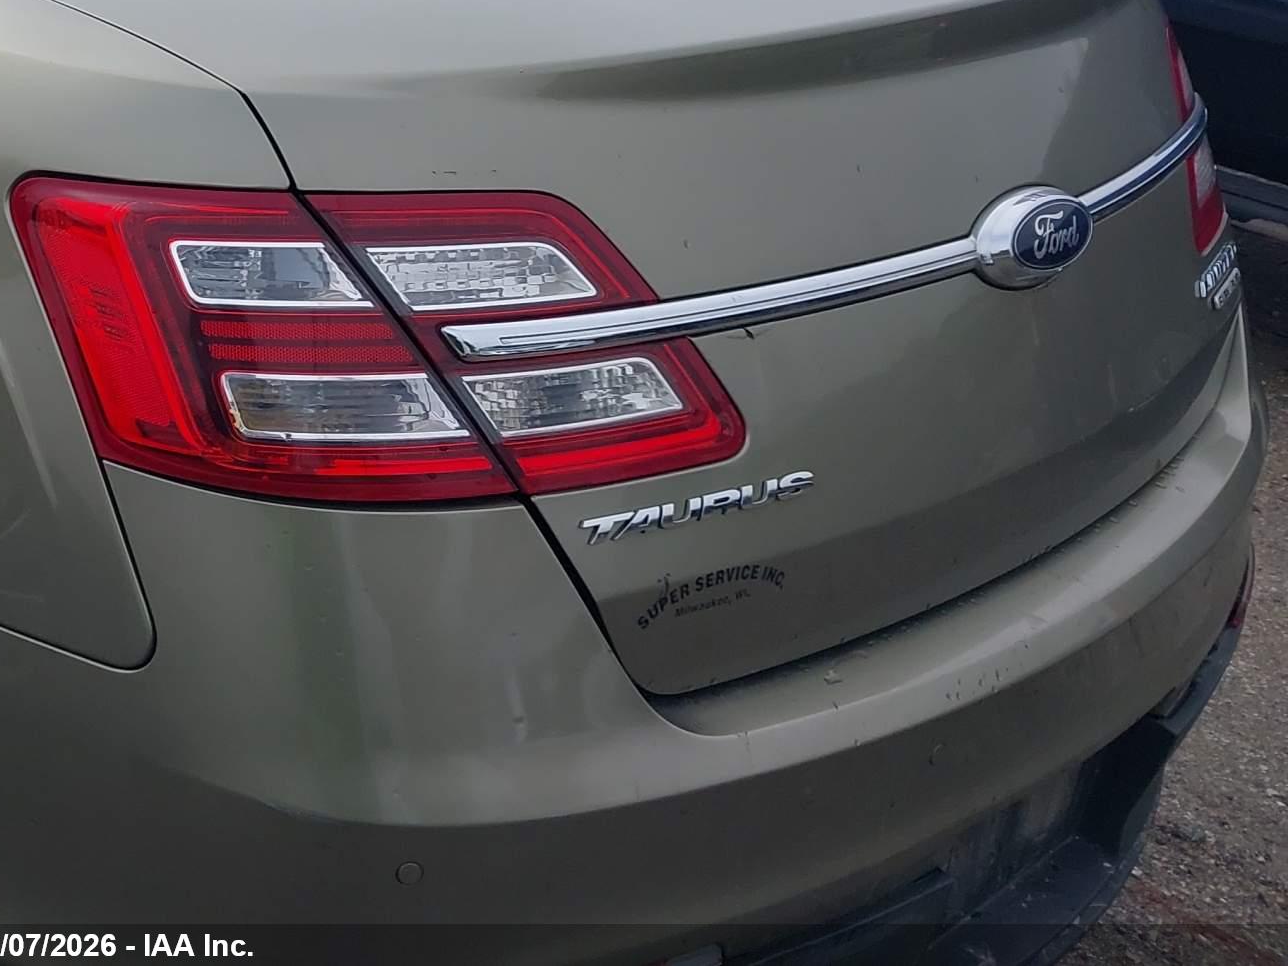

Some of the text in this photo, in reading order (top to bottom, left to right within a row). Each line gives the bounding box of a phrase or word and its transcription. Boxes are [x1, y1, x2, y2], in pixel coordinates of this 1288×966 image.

[1034, 210, 1080, 260] Ford
[579, 471, 815, 545] TAURUS
[637, 584, 691, 630] SUPER
[695, 564, 761, 592] SERVICE
